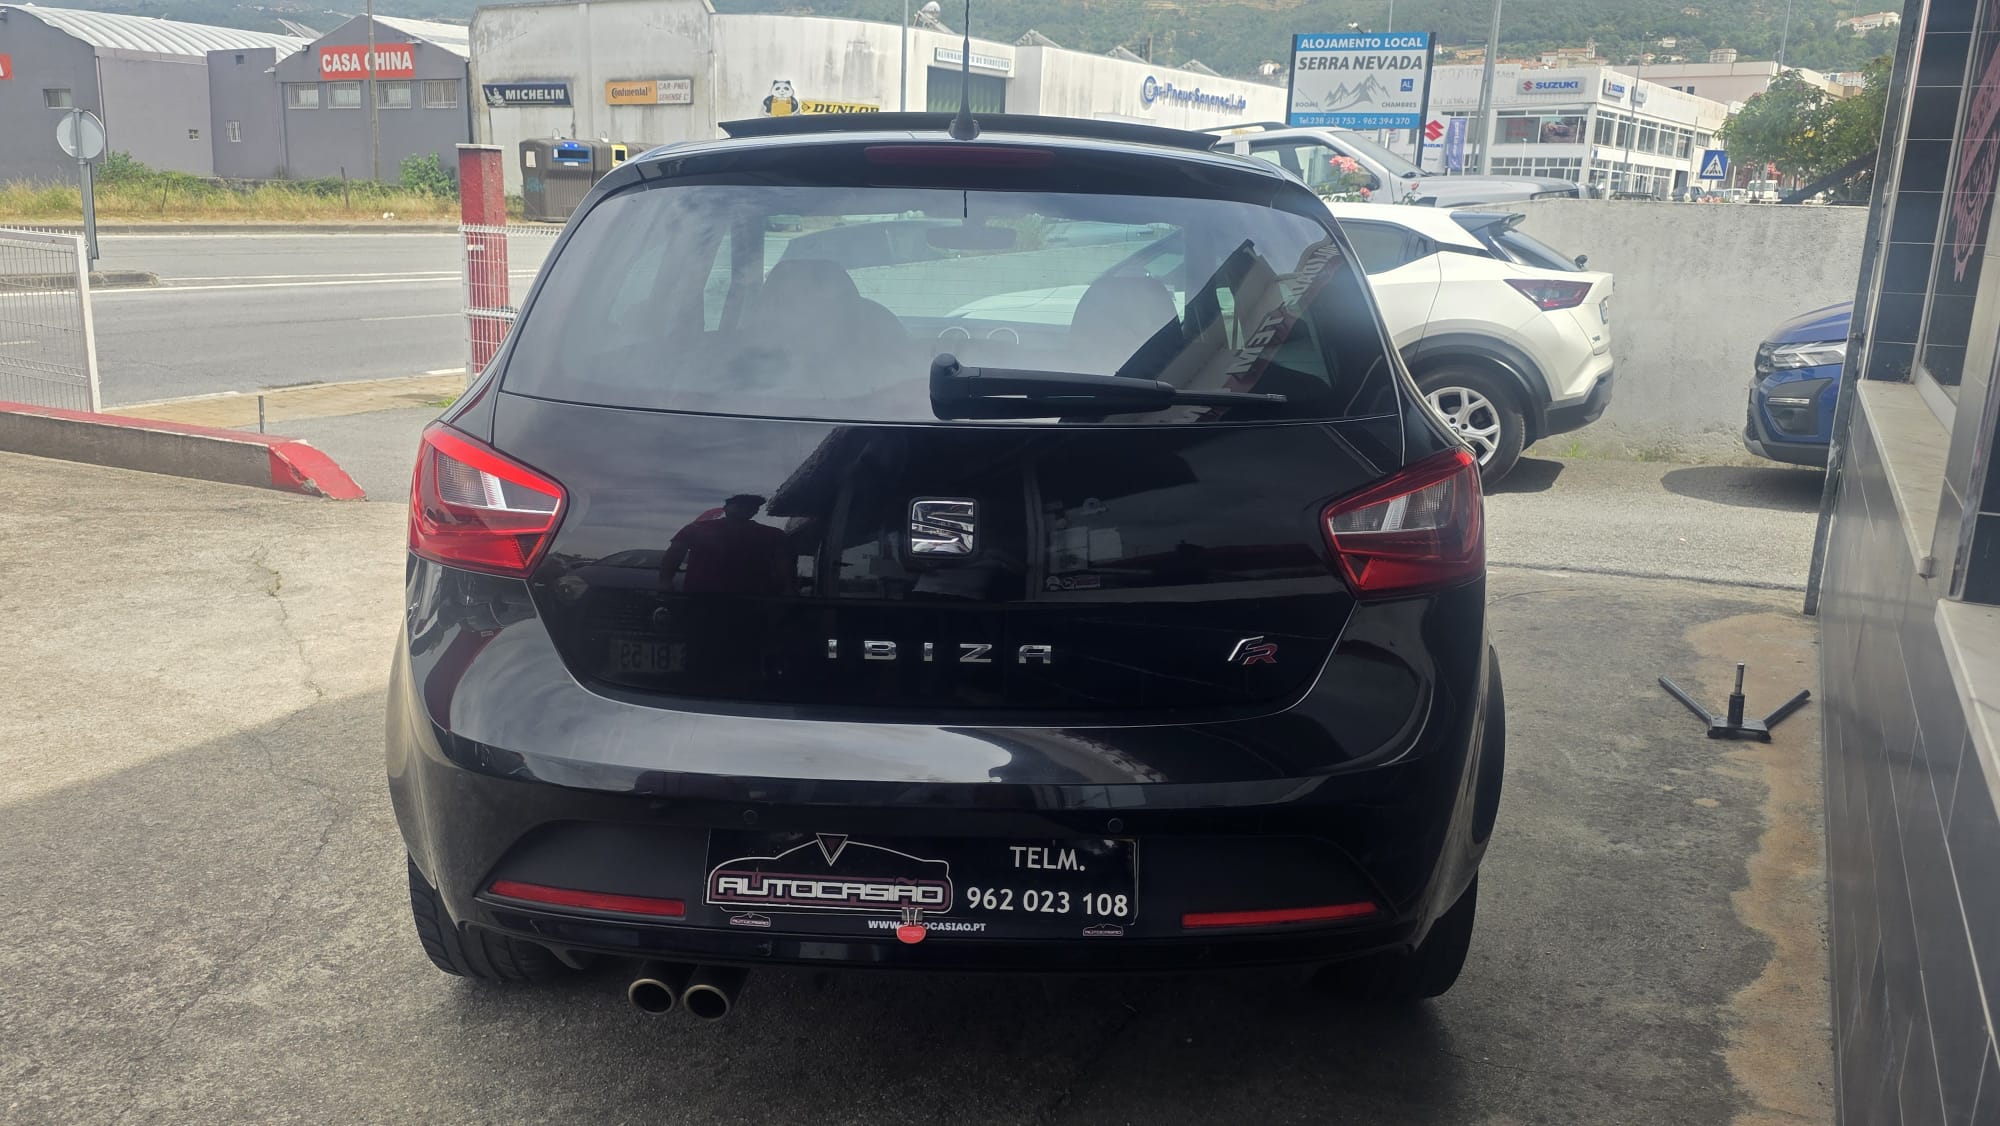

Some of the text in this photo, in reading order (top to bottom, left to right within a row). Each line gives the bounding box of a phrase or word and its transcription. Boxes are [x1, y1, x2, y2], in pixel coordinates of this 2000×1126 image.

[1301, 37, 1423, 49] ALOJAMENTO LOCAL
[322, 53, 361, 72] CASA
[1298, 55, 1422, 70] SERRA NEVADA
[1535, 81, 1579, 89] SUZUKI
[505, 88, 565, 100] MICHELIN
[611, 87, 648, 99] Continental
[1363, 116, 1377, 125] 962
[828, 639, 1051, 663] IBIZA
[1227, 635, 1278, 665] FR
[1009, 846, 1086, 872] TELM.
[967, 886, 1128, 917] 962 023 108
